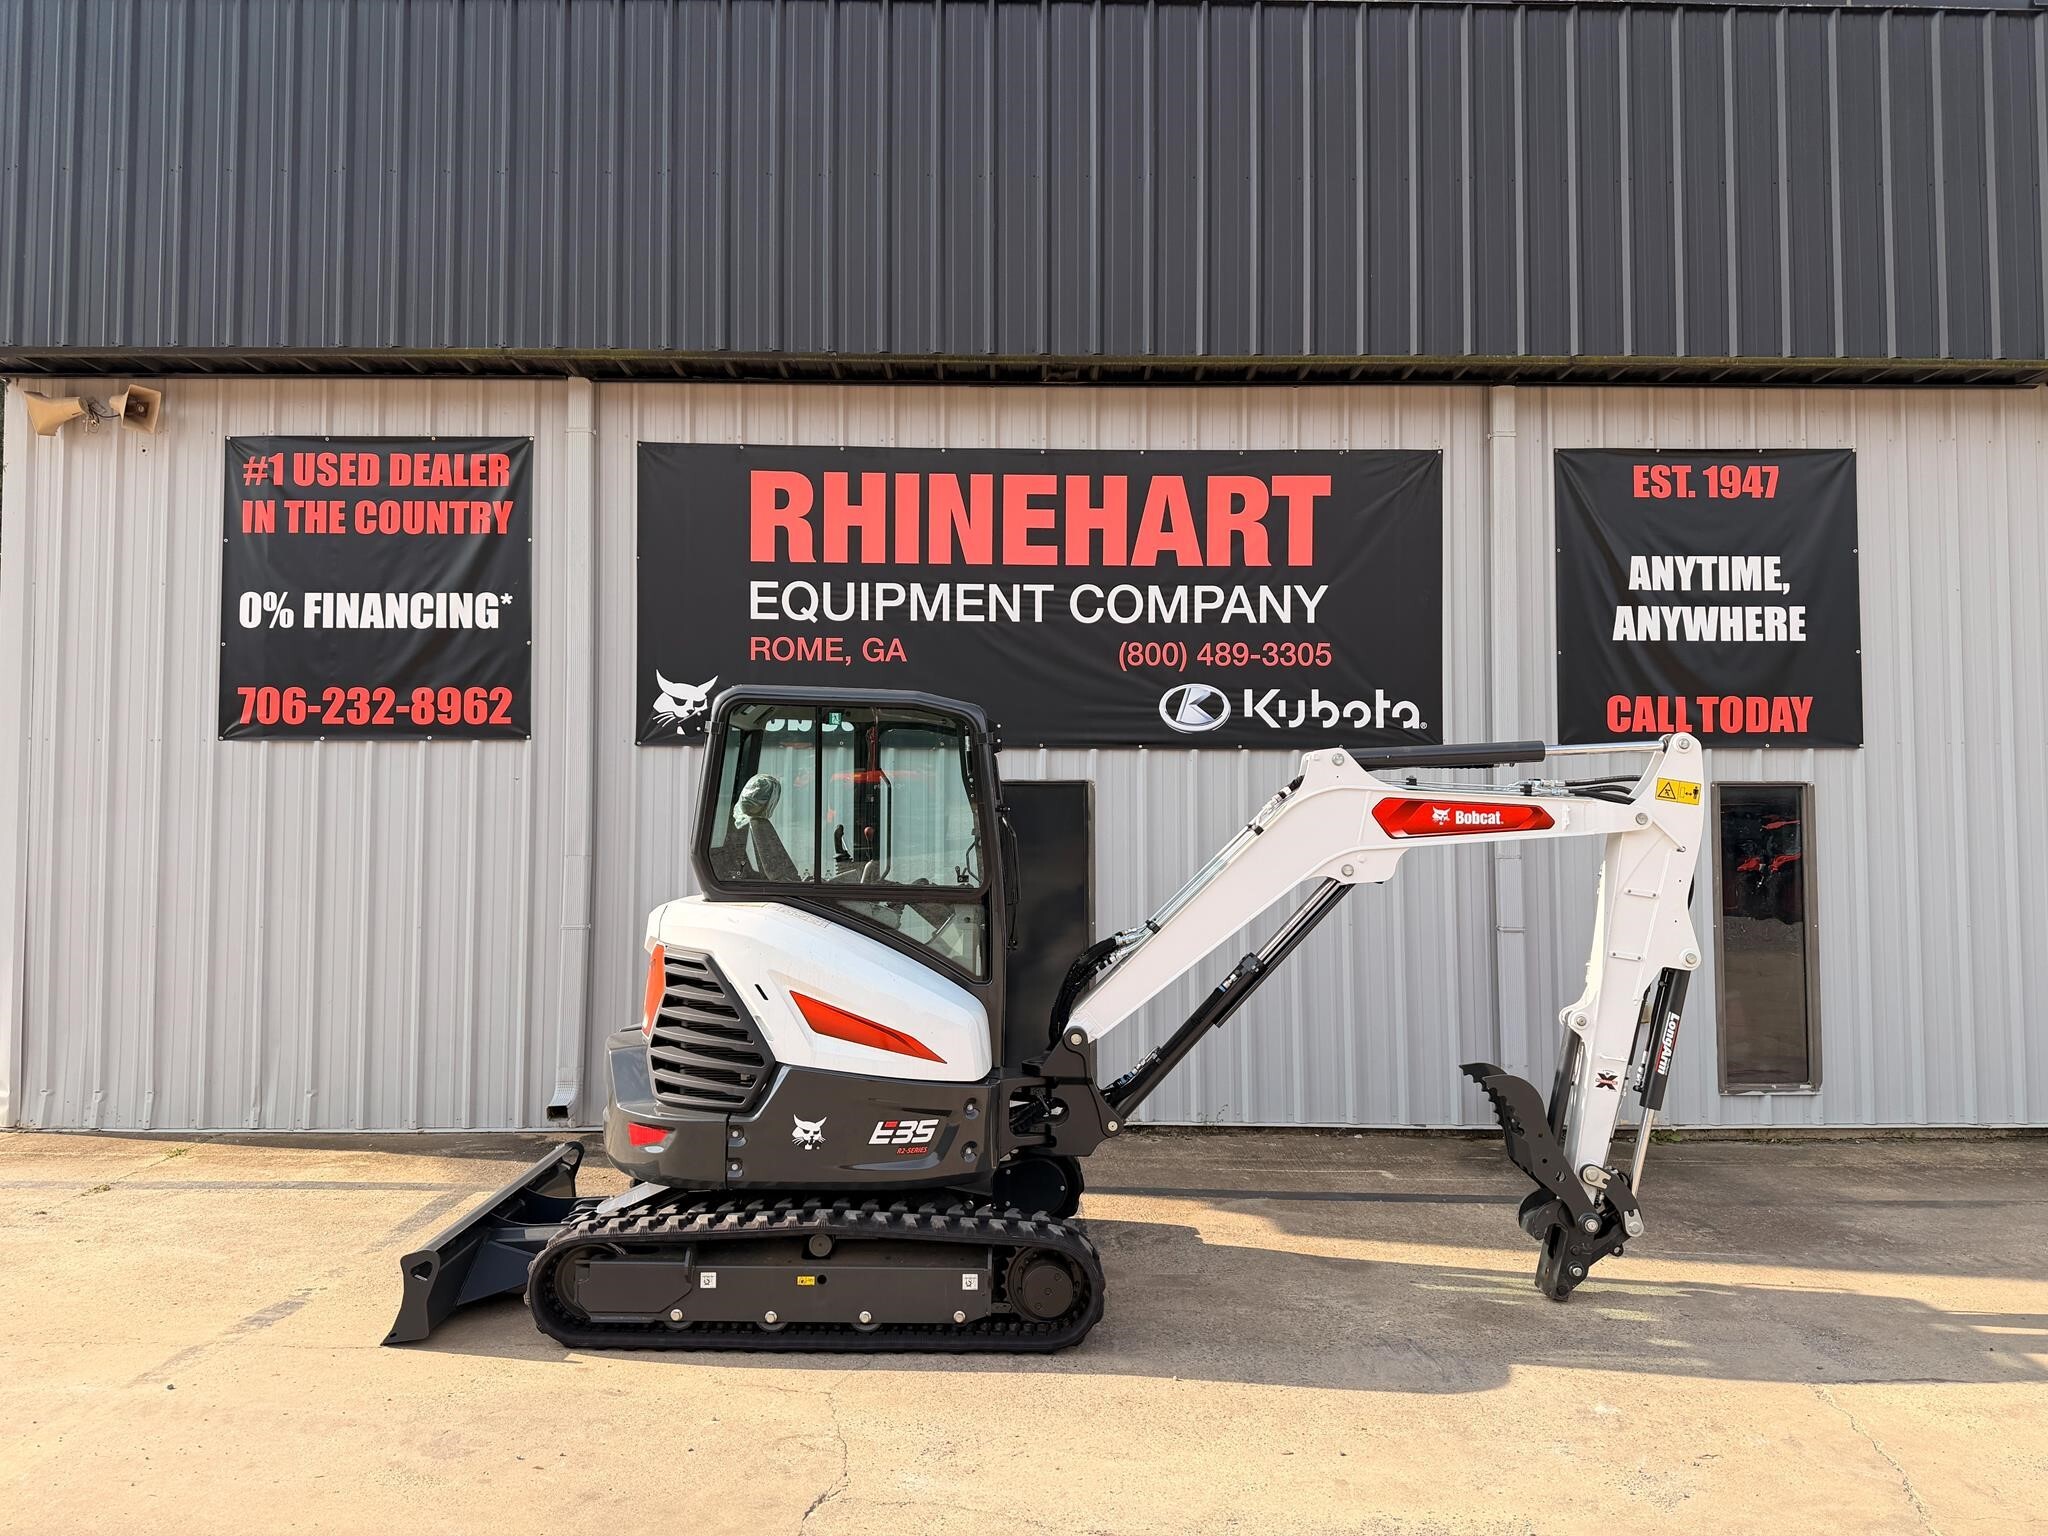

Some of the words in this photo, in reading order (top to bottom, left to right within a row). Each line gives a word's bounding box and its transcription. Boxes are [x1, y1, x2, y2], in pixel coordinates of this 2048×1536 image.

[243, 452, 284, 486] #1
[293, 452, 379, 487] USED
[389, 453, 511, 487] DEALER
[1632, 465, 1696, 498] EST.
[1702, 465, 1780, 499] 1947
[241, 500, 276, 534] IN
[283, 500, 346, 534] THE
[354, 500, 514, 535] COUNTRY
[750, 470, 1332, 567] RHINEHART
[1628, 556, 1790, 595] ANYTIME,
[239, 591, 295, 629] 0%
[750, 580, 1055, 624] EQUIPMENT
[1069, 583, 1329, 624] COMPANY
[1612, 605, 1807, 642] ANYWHERE
[749, 636, 852, 666] ROME,
[862, 637, 908, 663] GA
[1118, 641, 1188, 672] (800)
[1196, 641, 1333, 668] 489-3305
[237, 686, 513, 725] 706-232-8962
[1606, 695, 1693, 733] CALL
[1696, 695, 1813, 734] TODAY
[1455, 810, 1501, 825] Bobcat
[868, 1119, 939, 1145] E35
